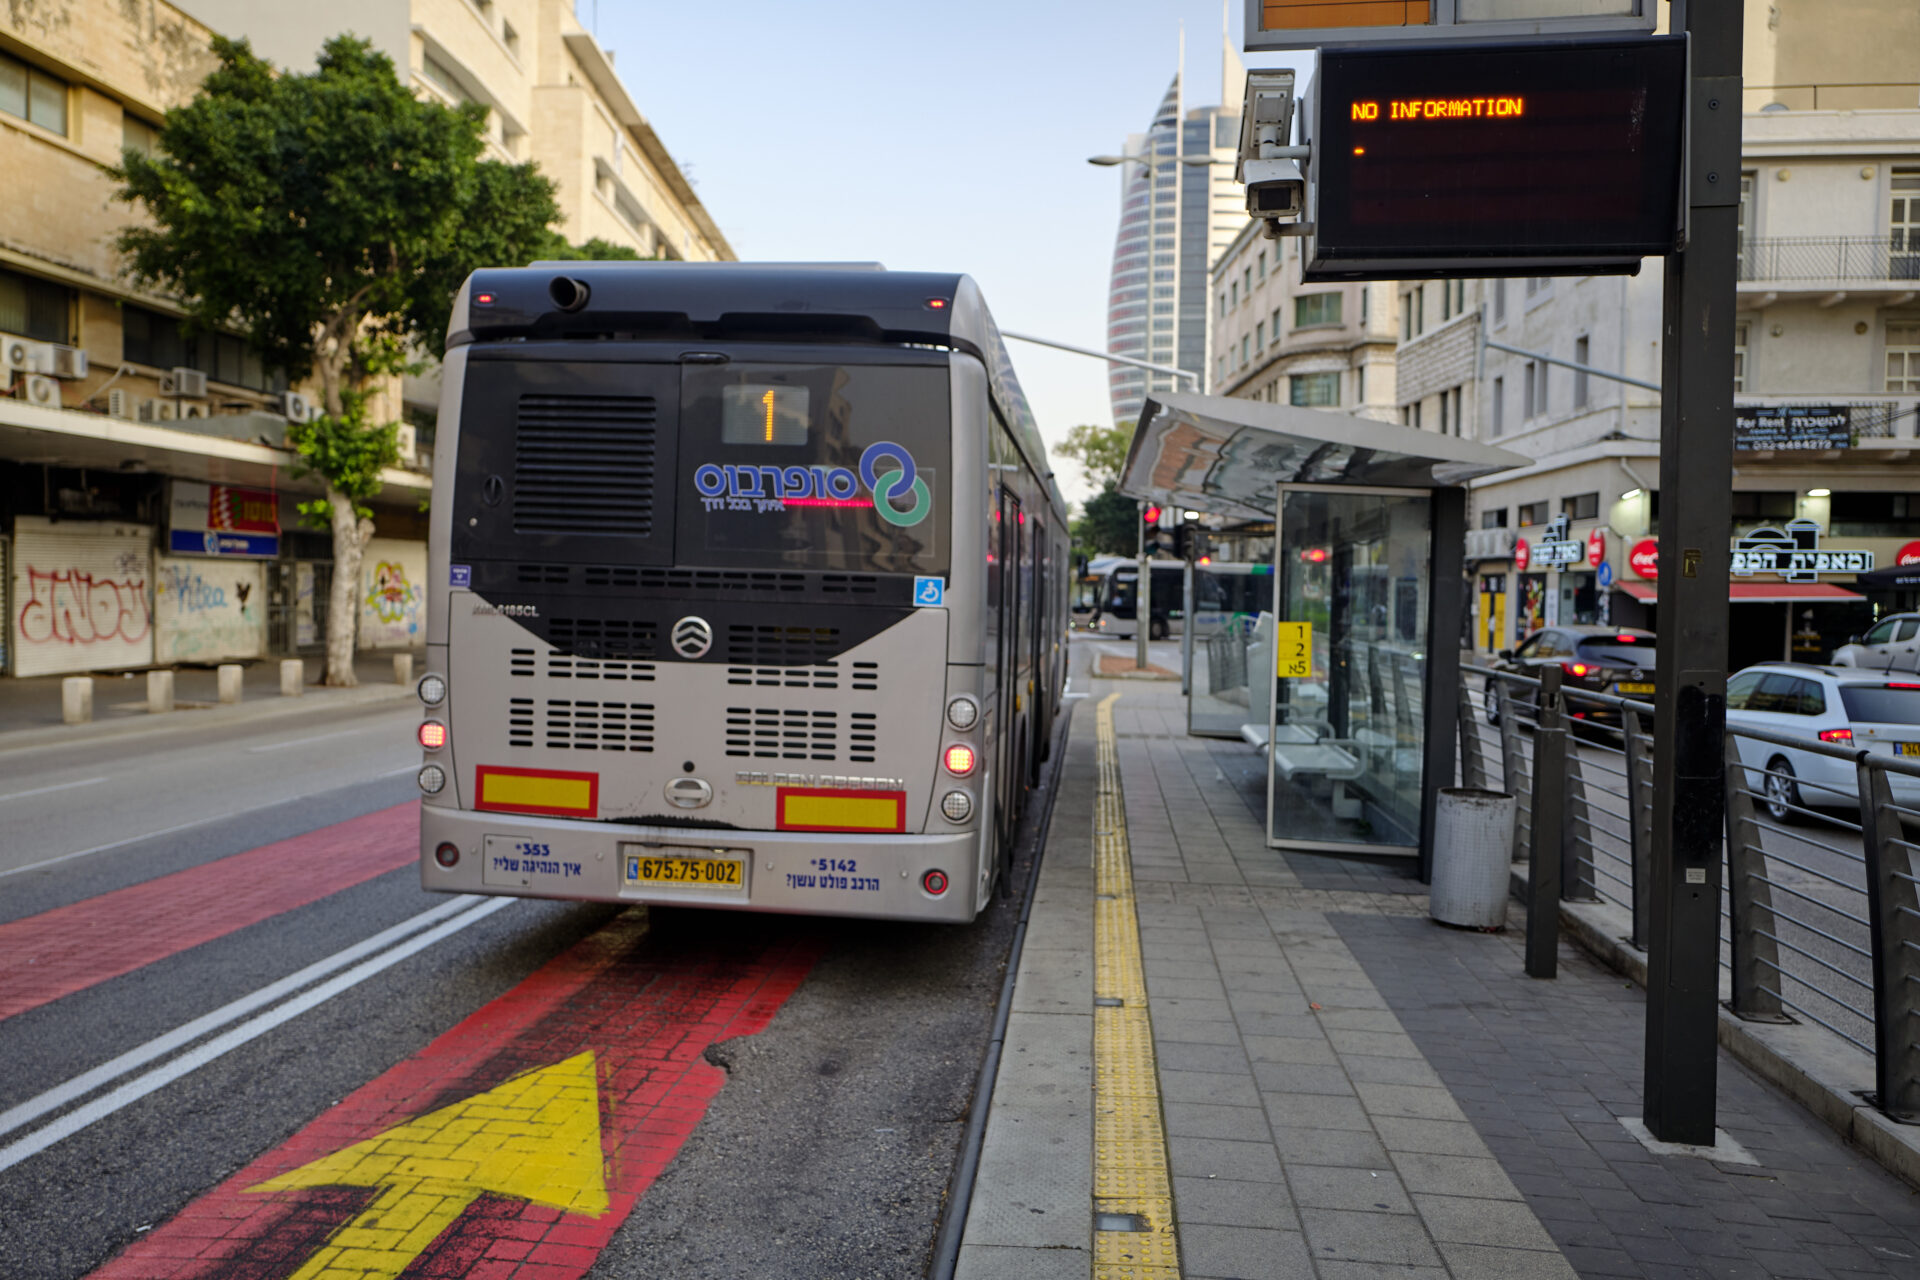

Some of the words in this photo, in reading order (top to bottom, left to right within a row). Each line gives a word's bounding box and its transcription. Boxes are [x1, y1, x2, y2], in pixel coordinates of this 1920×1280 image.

[1352, 103, 1378, 119] NO
[1391, 98, 1522, 119] INFORMATION
[762, 390, 774, 441] 1
[1736, 416, 1756, 429] For
[1758, 416, 1785, 428] Rent
[1791, 413, 1846, 428] להשכרה
[694, 463, 858, 500] סופרבוס
[700, 496, 724, 513] דרך
[725, 494, 752, 511] בכל
[1731, 552, 1777, 570] המפ
[1790, 552, 1864, 570] מאפית
[1296, 624, 1304, 639] 1
[1295, 642, 1305, 657] 2
[493, 855, 519, 872] שלי?
[522, 859, 560, 874] הנהיגה
[563, 861, 582, 877] איך
[786, 873, 816, 889] עשן?
[820, 872, 848, 889] פולט
[850, 877, 880, 892] הרכב
